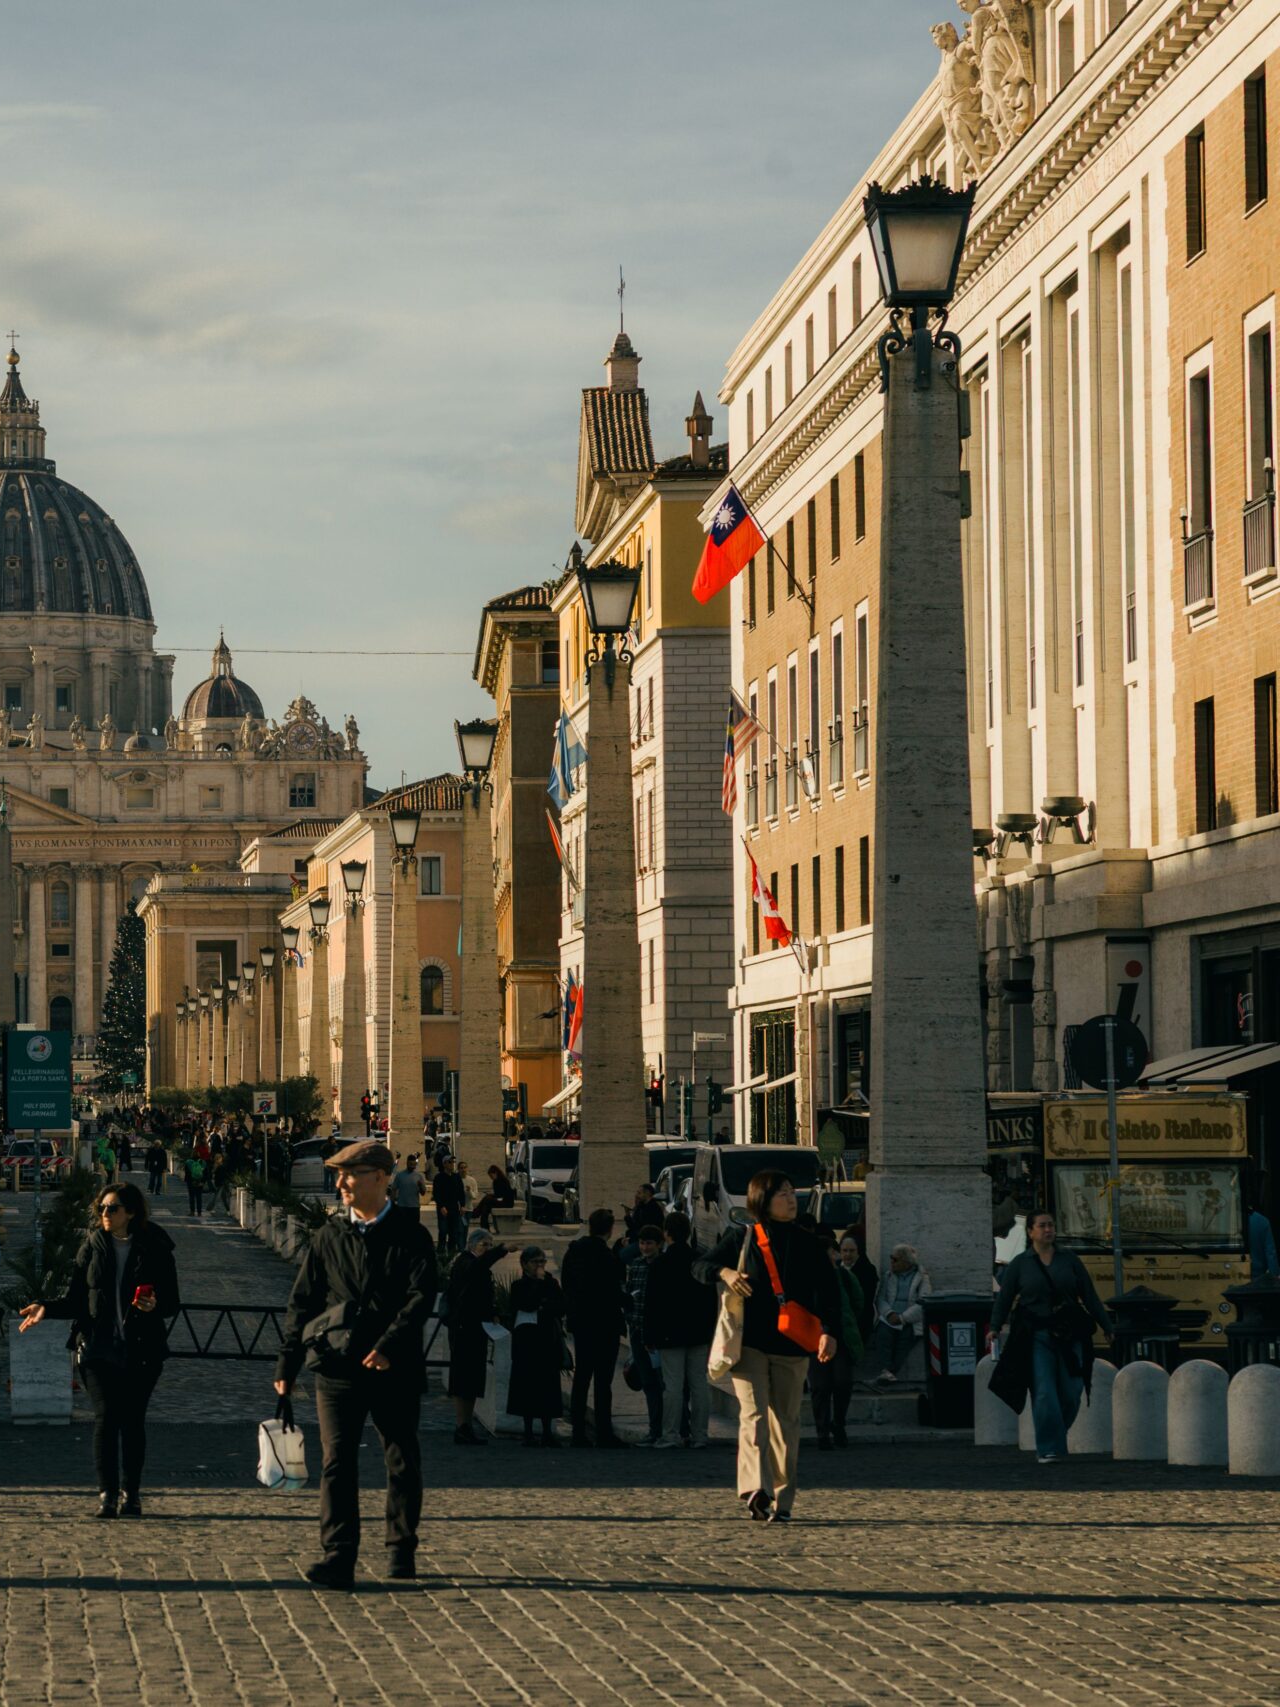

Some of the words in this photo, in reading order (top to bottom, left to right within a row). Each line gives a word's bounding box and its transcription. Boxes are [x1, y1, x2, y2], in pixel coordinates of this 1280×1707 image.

[34, 840, 90, 848] ROMANVS
[987, 1115, 1035, 1142] INKS
[1083, 1119, 1097, 1140] Il
[1164, 1118, 1234, 1140] Italiano
